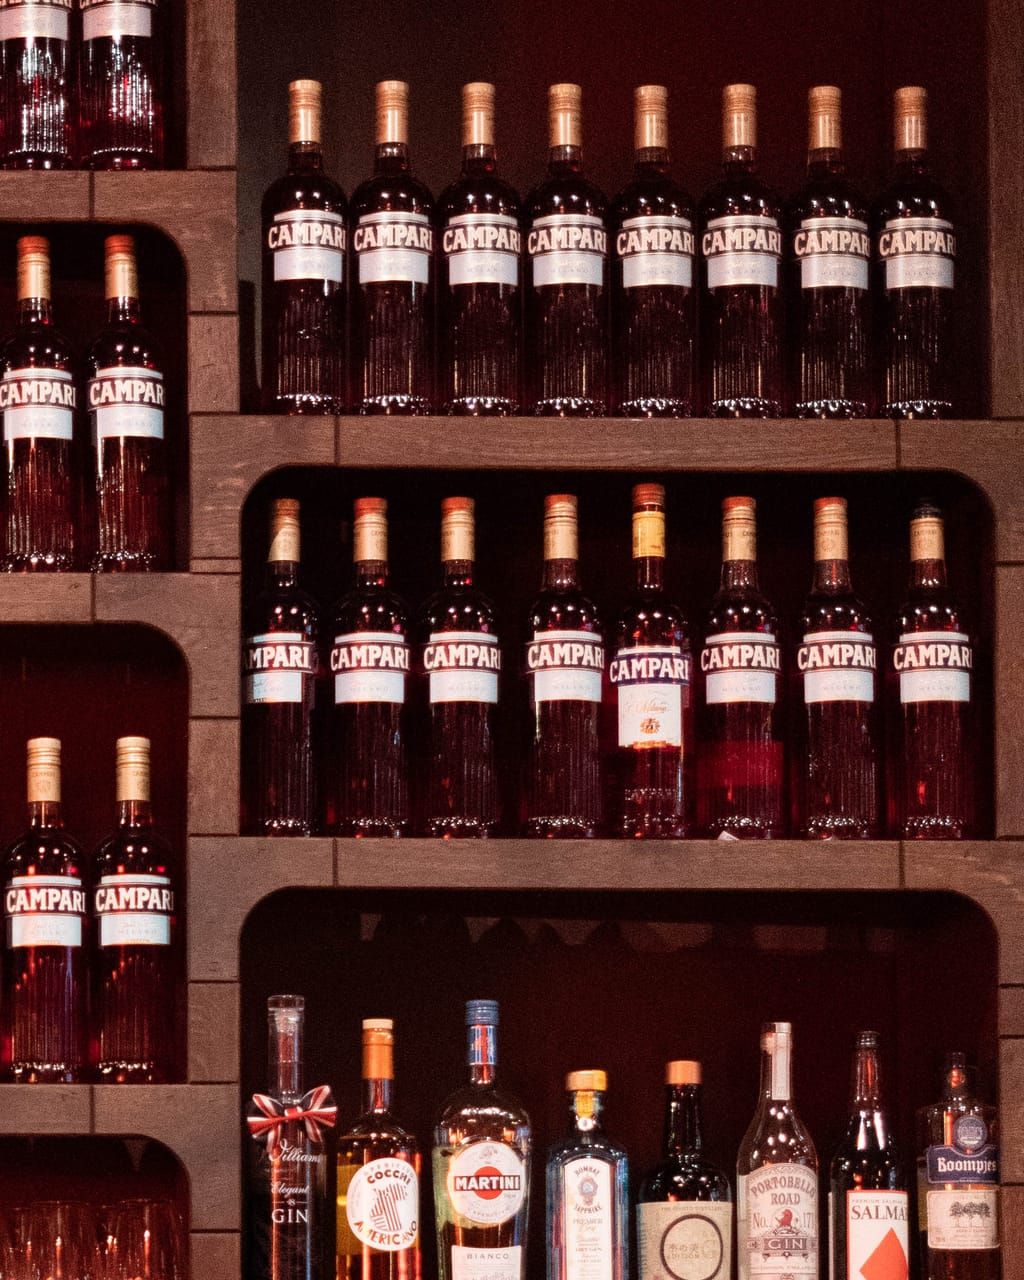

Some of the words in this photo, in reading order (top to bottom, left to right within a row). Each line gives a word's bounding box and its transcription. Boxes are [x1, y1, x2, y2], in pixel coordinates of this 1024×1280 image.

[268, 222, 346, 249] CAMPARI
[354, 224, 432, 251] CAMPARI
[443, 226, 521, 252] CAMPARI
[528, 226, 606, 253] CAMPARI
[616, 228, 694, 255] CAMPARI
[703, 229, 781, 255] CAMPARI
[795, 230, 870, 256] CAMPARI
[879, 230, 957, 256] CAMPARI
[89, 380, 164, 406] CAMPAR
[331, 645, 409, 670] CAMPARI
[424, 644, 501, 669] CAMPARI
[528, 643, 604, 669] CAMPARI
[701, 645, 781, 671] CAMPARI
[798, 643, 876, 669] CAMPARI
[894, 643, 972, 669] CAMPARI
[609, 657, 689, 682] CAMPARI
[6, 887, 85, 912] CAMPARI
[95, 887, 173, 912] CAMPARI
[367, 1169, 411, 1185] COCCHI
[574, 1166, 601, 1177] BOMBAY
[937, 1156, 997, 1174] Boompjes
[456, 1176, 519, 1190] MARTINI
[750, 1176, 816, 1198] PORTOBELLO
[771, 1192, 801, 1205] ROAD
[271, 1208, 309, 1223] GIN
[767, 1238, 803, 1249] GIN
